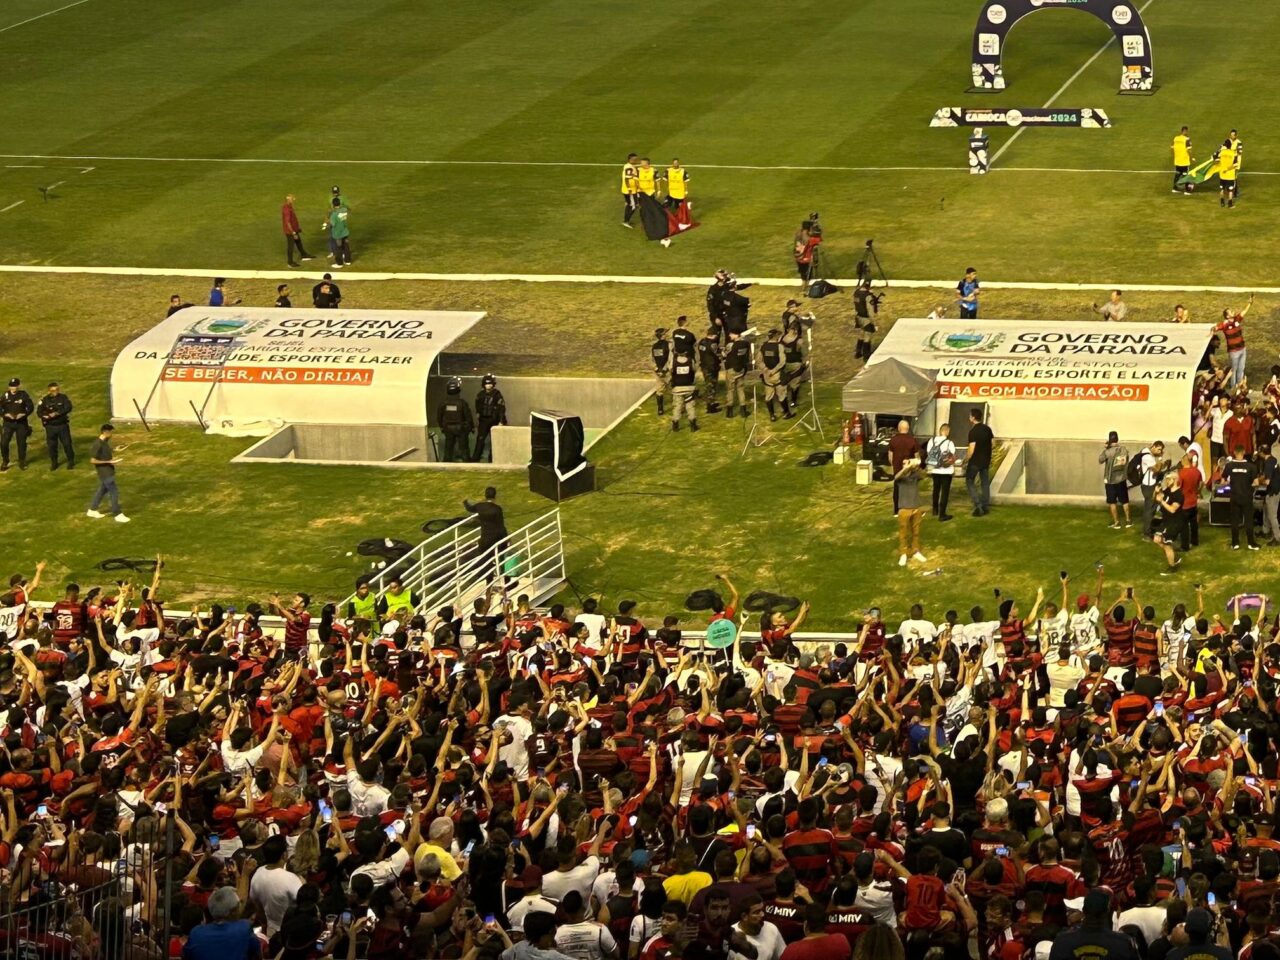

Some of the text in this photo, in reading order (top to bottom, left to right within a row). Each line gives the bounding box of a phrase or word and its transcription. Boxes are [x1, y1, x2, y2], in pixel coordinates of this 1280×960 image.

[965, 112, 1006, 122] CARIOCA
[1052, 113, 1077, 122] 2024
[279, 318, 424, 330] GOVERNO
[263, 329, 305, 338] DA
[1017, 332, 1169, 344] GOVERNO
[1009, 343, 1188, 355] DA PARAÍBA
[135, 351, 157, 360] DA
[268, 354, 343, 364] ESPORTE
[345, 355, 356, 364] E
[360, 356, 413, 365] LAZER
[165, 367, 187, 379] SE
[261, 368, 298, 382] NÃO
[303, 370, 370, 383] DIRIJA!
[1033, 369, 1111, 379] ESPORTE
[1117, 370, 1127, 379] E
[1131, 370, 1188, 380] LAZER
[978, 385, 1017, 396] COM
[1022, 385, 1141, 399] MODERAÇÃO!
[345, 682, 359, 699] 10
[917, 882, 932, 906] 10
[773, 905, 797, 917] MRV
[838, 913, 863, 923] MRV
